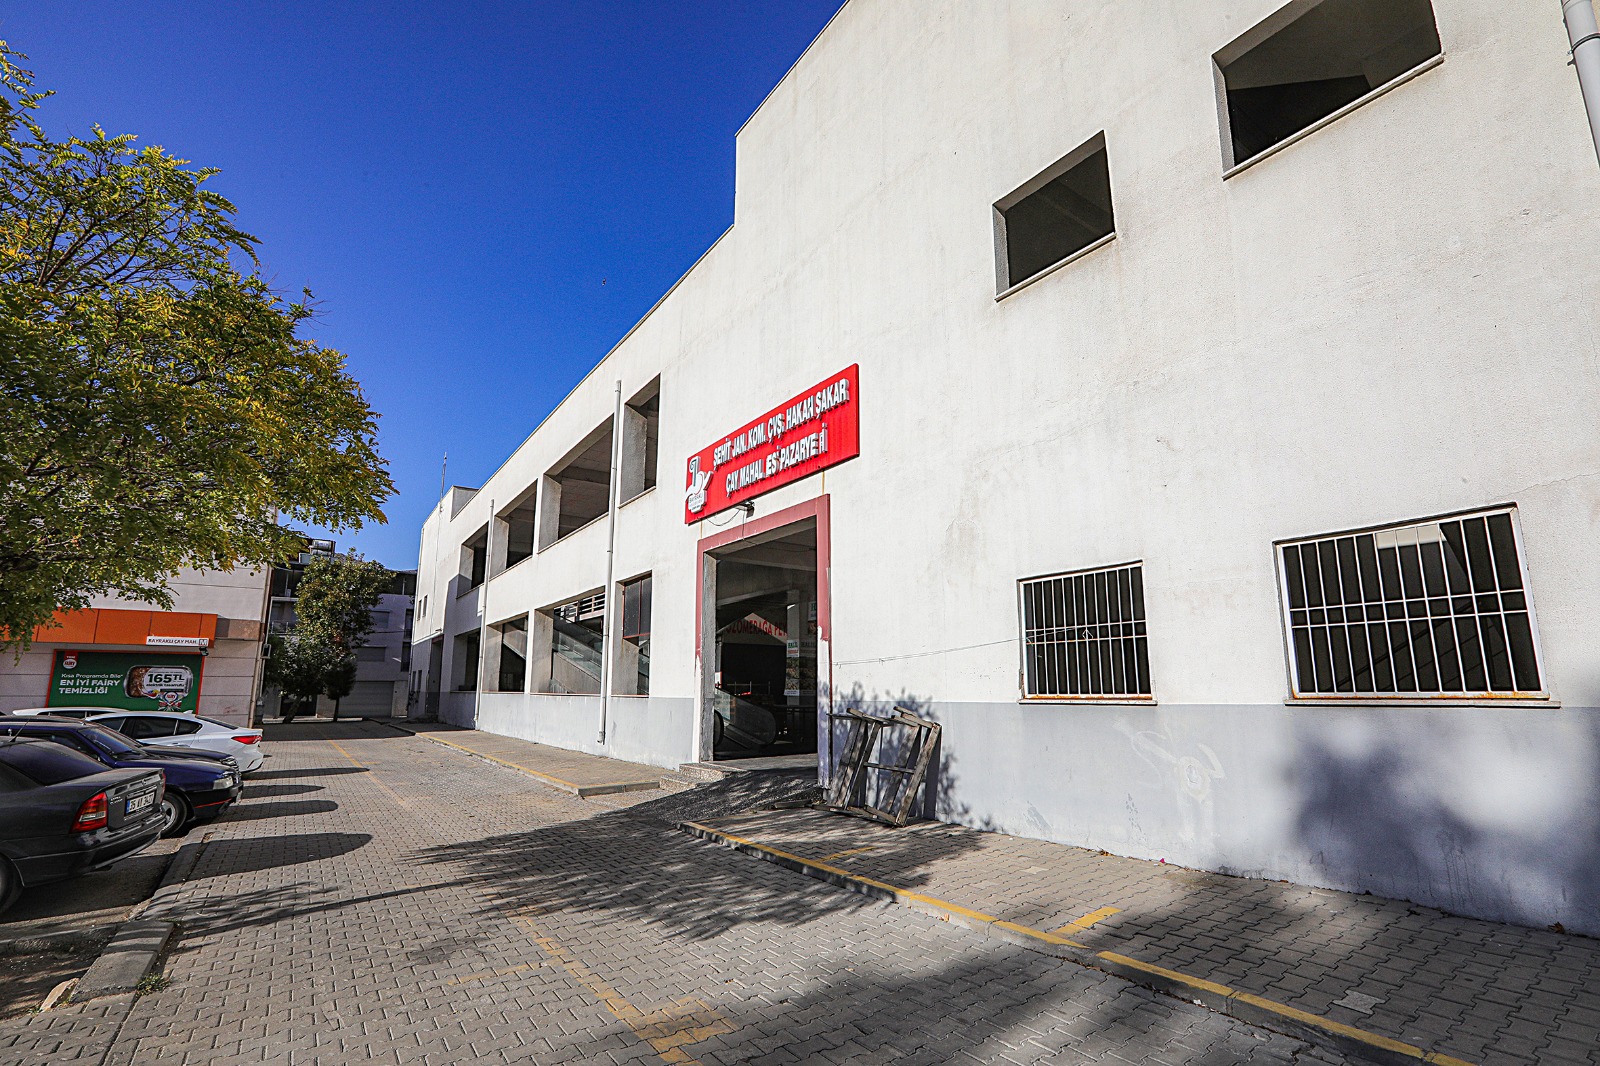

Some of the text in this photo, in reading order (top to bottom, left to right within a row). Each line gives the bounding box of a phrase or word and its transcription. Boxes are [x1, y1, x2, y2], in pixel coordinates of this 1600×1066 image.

[786, 395, 815, 429] HAKAN
[815, 378, 850, 419] ŞAKAR
[726, 473, 740, 497] ÇAY
[148, 674, 172, 683] 165
